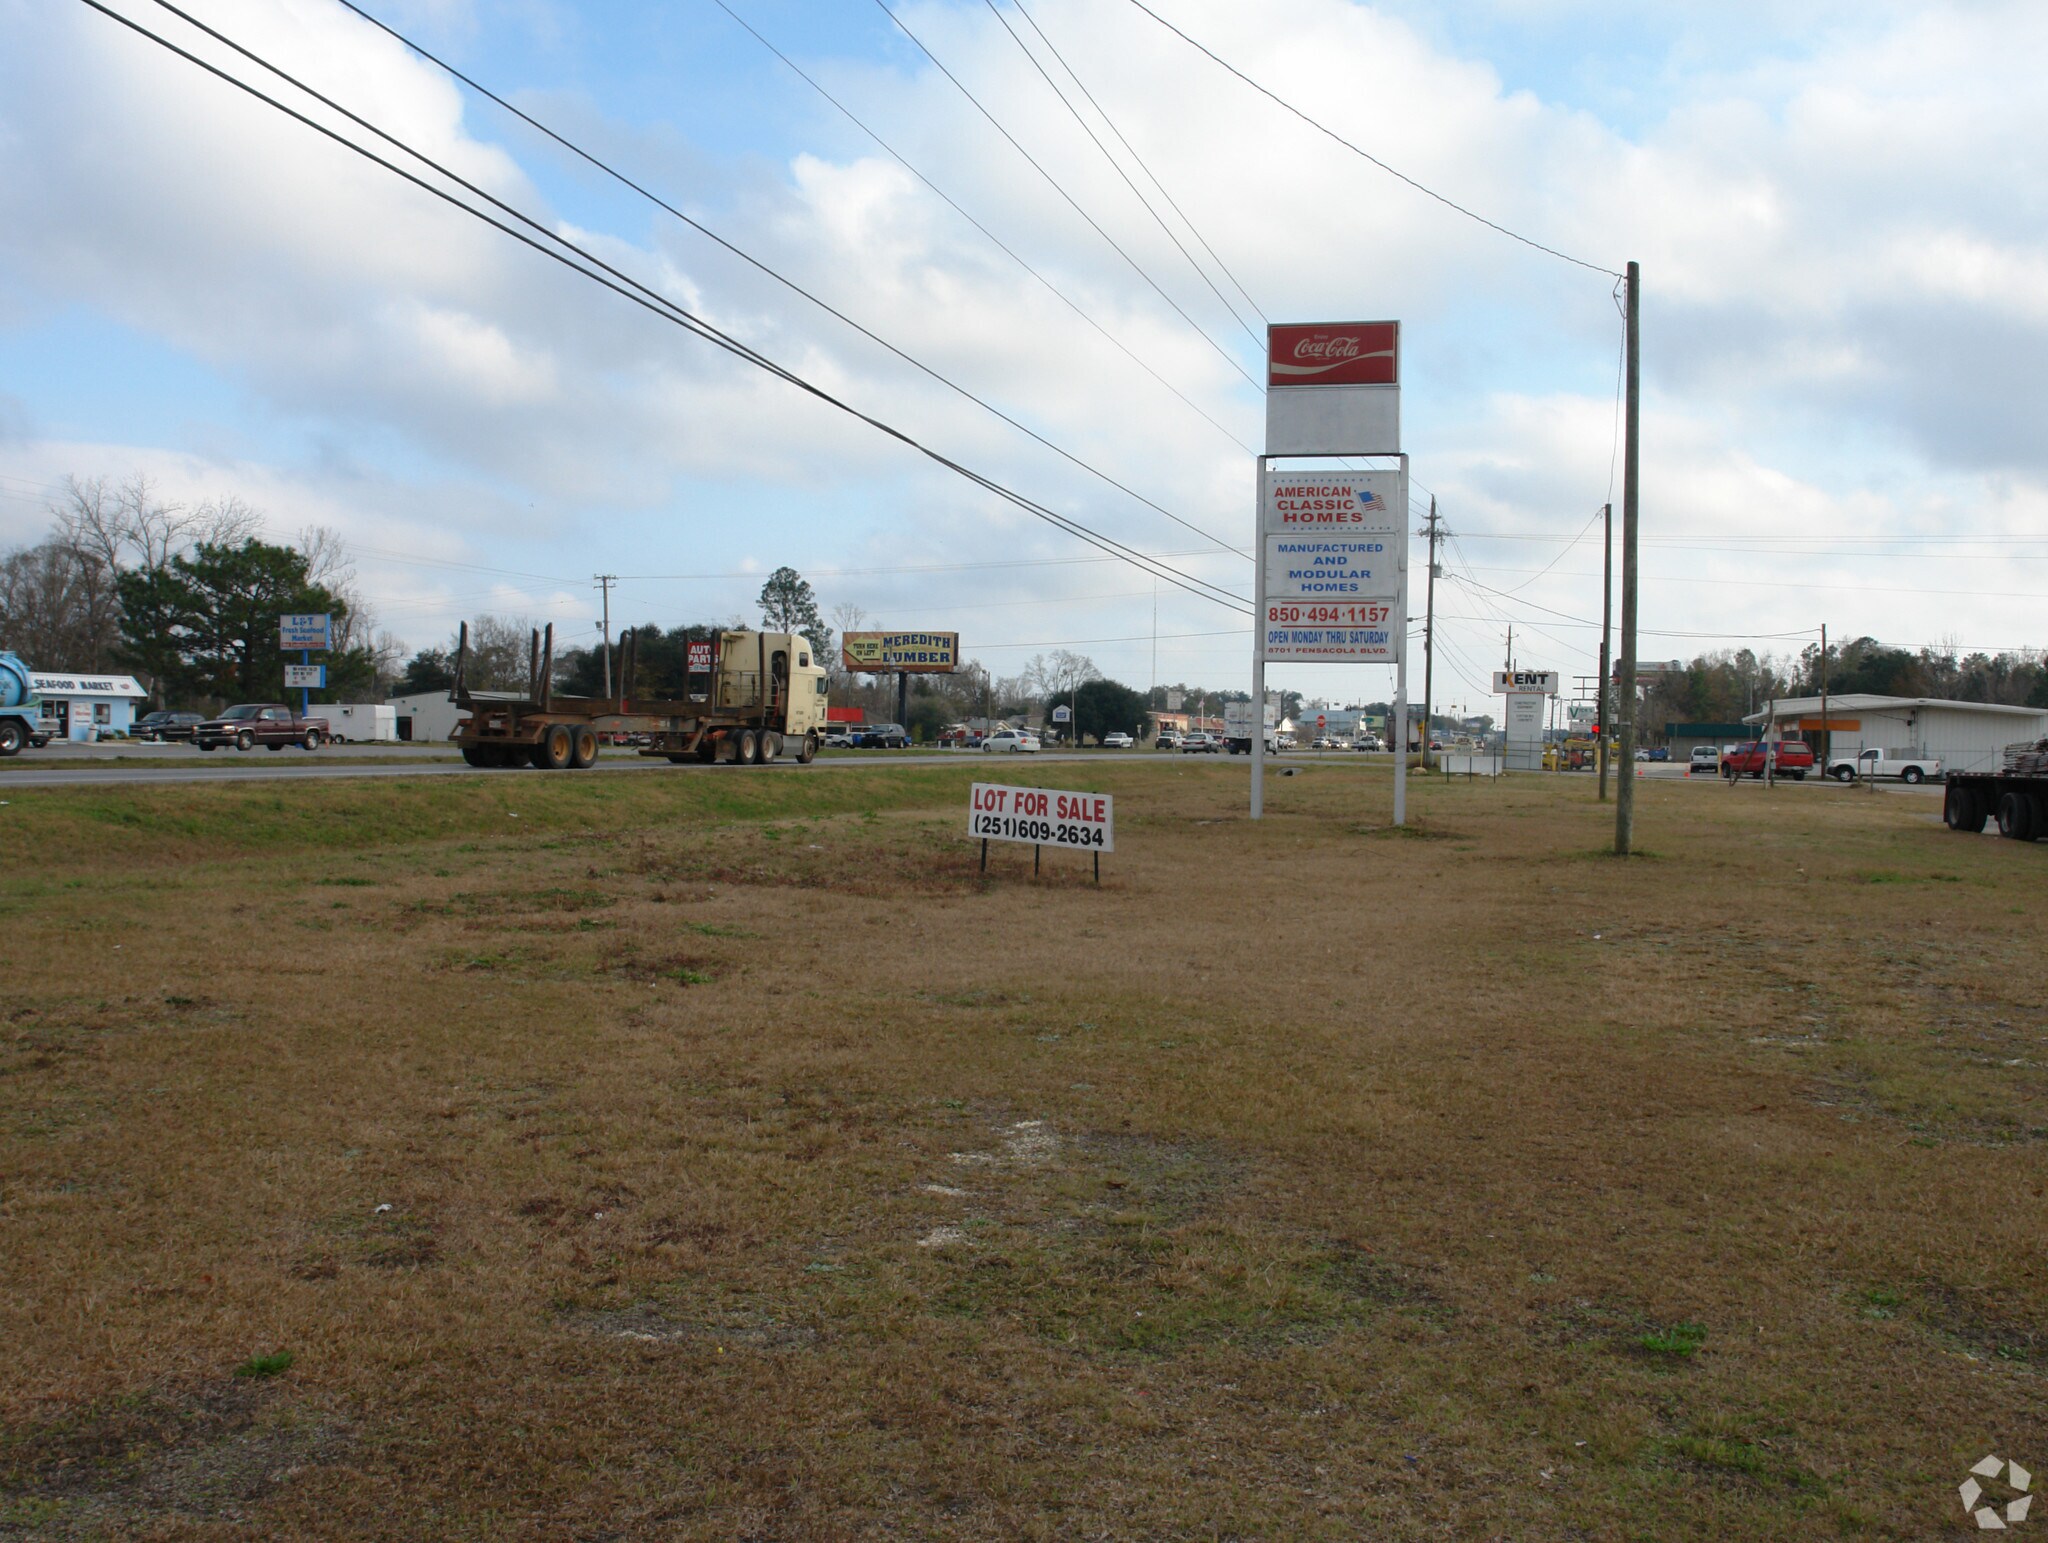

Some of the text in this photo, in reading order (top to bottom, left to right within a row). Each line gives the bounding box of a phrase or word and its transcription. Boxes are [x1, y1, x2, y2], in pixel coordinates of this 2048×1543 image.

[1293, 336, 1361, 359] Coca-Cola
[1274, 486, 1351, 498] AMERICAN
[1277, 499, 1355, 511] CLASSIC
[1283, 512, 1363, 523] HOMES
[1278, 543, 1383, 553] MANUFACTURED
[1313, 556, 1348, 565] AND
[1289, 570, 1371, 579] MODULAR
[1301, 583, 1359, 592] HOMES
[882, 634, 951, 648] MEREDITH
[1268, 631, 1390, 644] OPEN MONDAY THRU SATURDAY
[690, 645, 711, 654] AUT
[882, 652, 951, 663] LUMBER
[34, 679, 114, 691] SEAFOOD MARKET
[1502, 673, 1549, 688] KENT
[974, 788, 1106, 823] LOT FOR SALE
